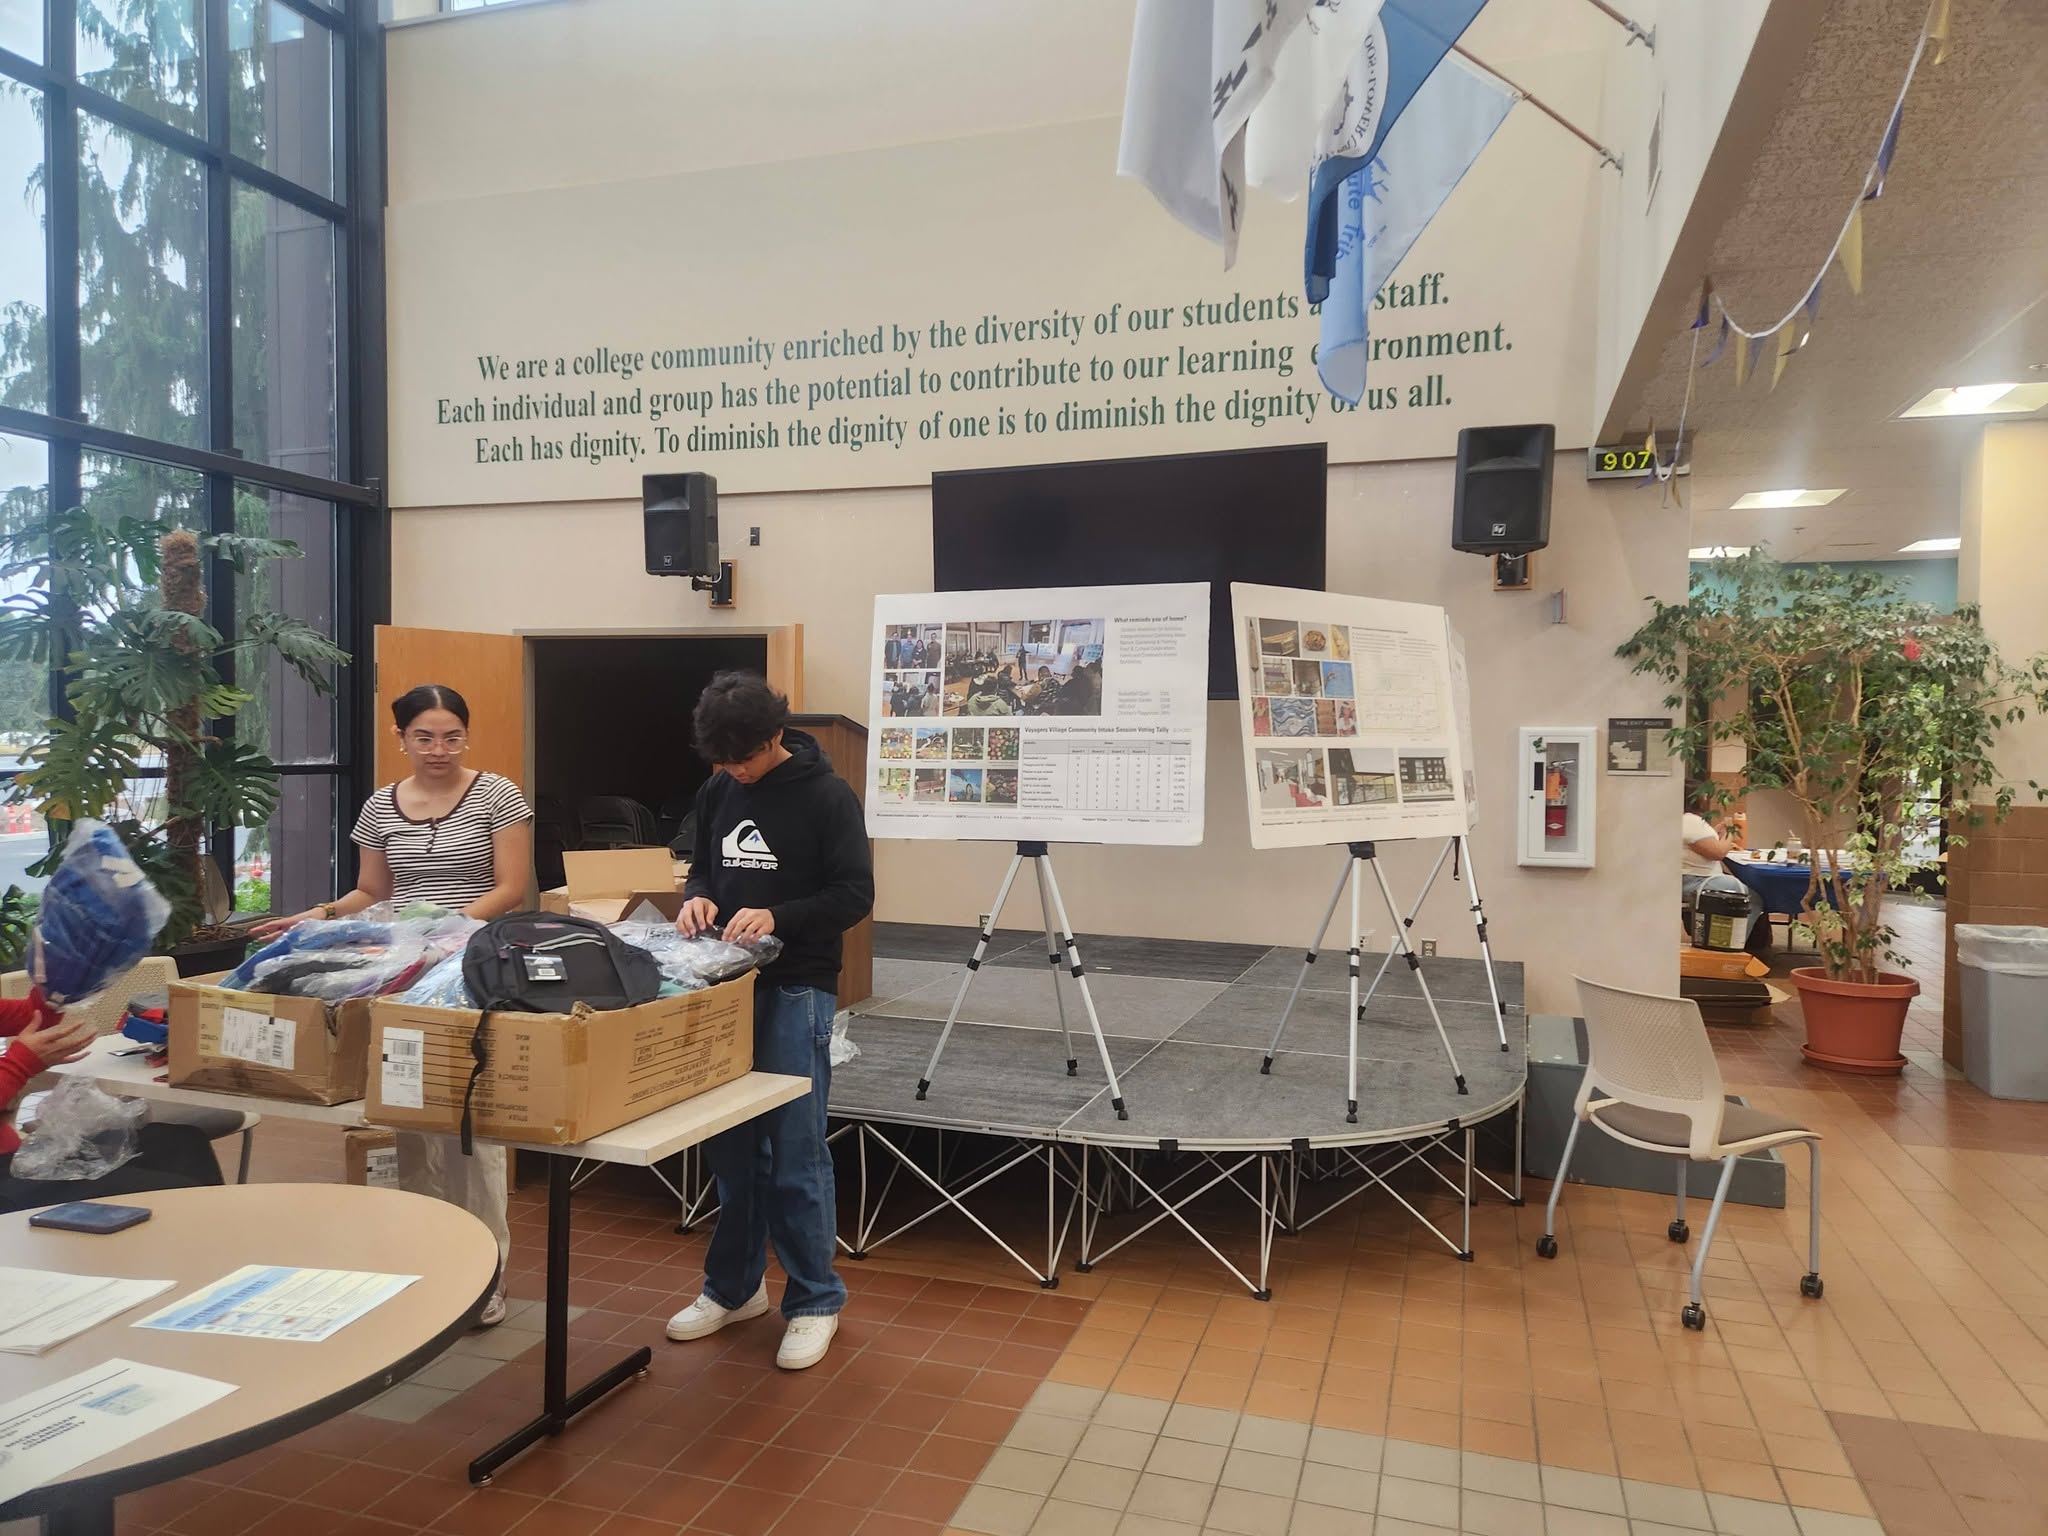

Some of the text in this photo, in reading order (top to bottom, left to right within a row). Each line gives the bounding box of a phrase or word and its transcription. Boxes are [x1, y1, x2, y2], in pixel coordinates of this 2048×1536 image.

[477, 354, 509, 381] We
[516, 358, 547, 379] are
[554, 357, 566, 377] a
[573, 347, 644, 381] college
[651, 336, 775, 371] community
[783, 325, 884, 361] enriched
[893, 324, 921, 360] by
[929, 319, 967, 349] the
[974, 308, 1085, 346] diversity
[1093, 303, 1122, 335] of
[1128, 306, 1174, 332] our
[1182, 290, 1299, 328] students
[1374, 272, 1449, 311] staff.
[437, 397, 486, 425] Each
[492, 390, 596, 422] individual
[603, 387, 643, 416] and
[649, 390, 714, 422] group
[721, 381, 758, 409] has
[765, 377, 800, 406] the
[807, 367, 911, 411] potential
[918, 368, 942, 394] to
[950, 357, 1081, 392] contribute
[1089, 355, 1114, 382] to
[1123, 355, 1170, 380] our
[1177, 339, 1295, 378] learning
[475, 374, 1452, 466] Each has dignity. To diminish the dignity of one is to diminish the dignity o us all.
